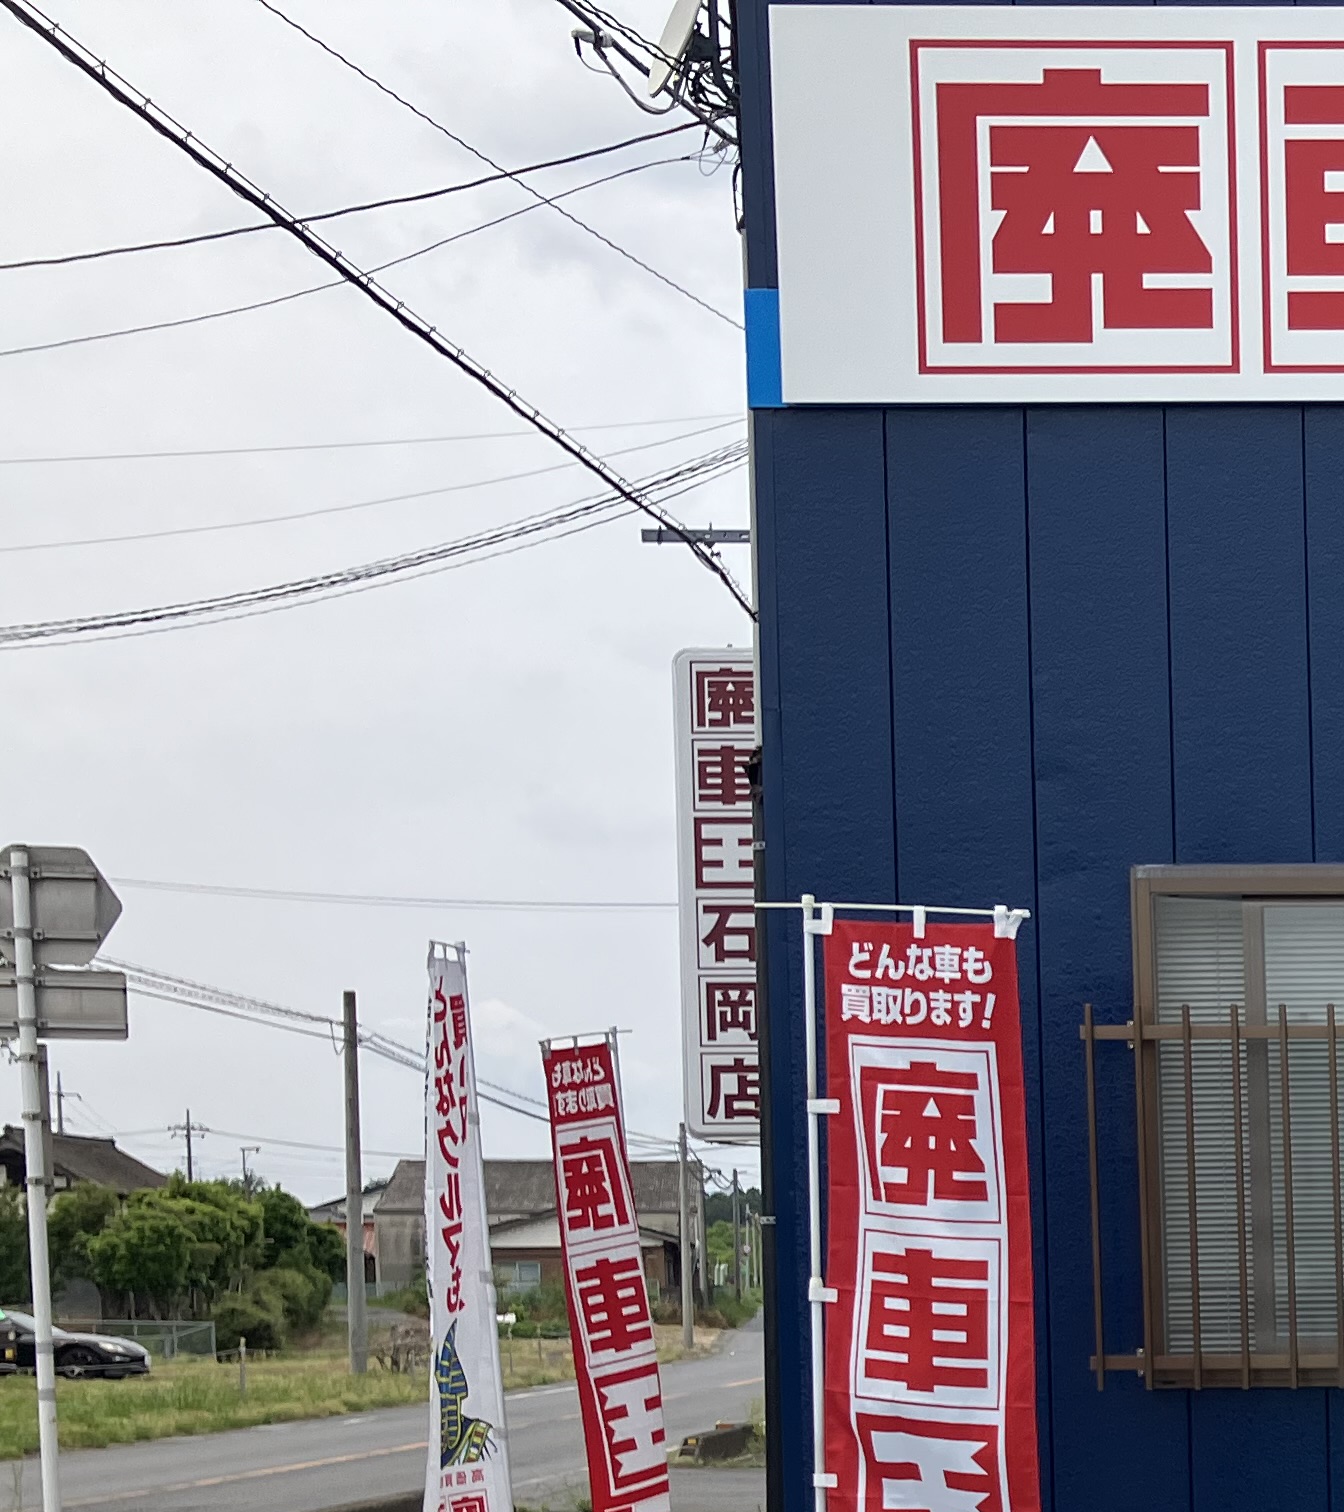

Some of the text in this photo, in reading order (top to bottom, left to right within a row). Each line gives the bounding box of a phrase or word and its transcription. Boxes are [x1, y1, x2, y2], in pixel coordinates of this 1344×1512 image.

[695, 667, 760, 1121] 廃車王石岡店
[847, 941, 993, 985] どんな車も
[840, 983, 997, 1030] 買取ります!
